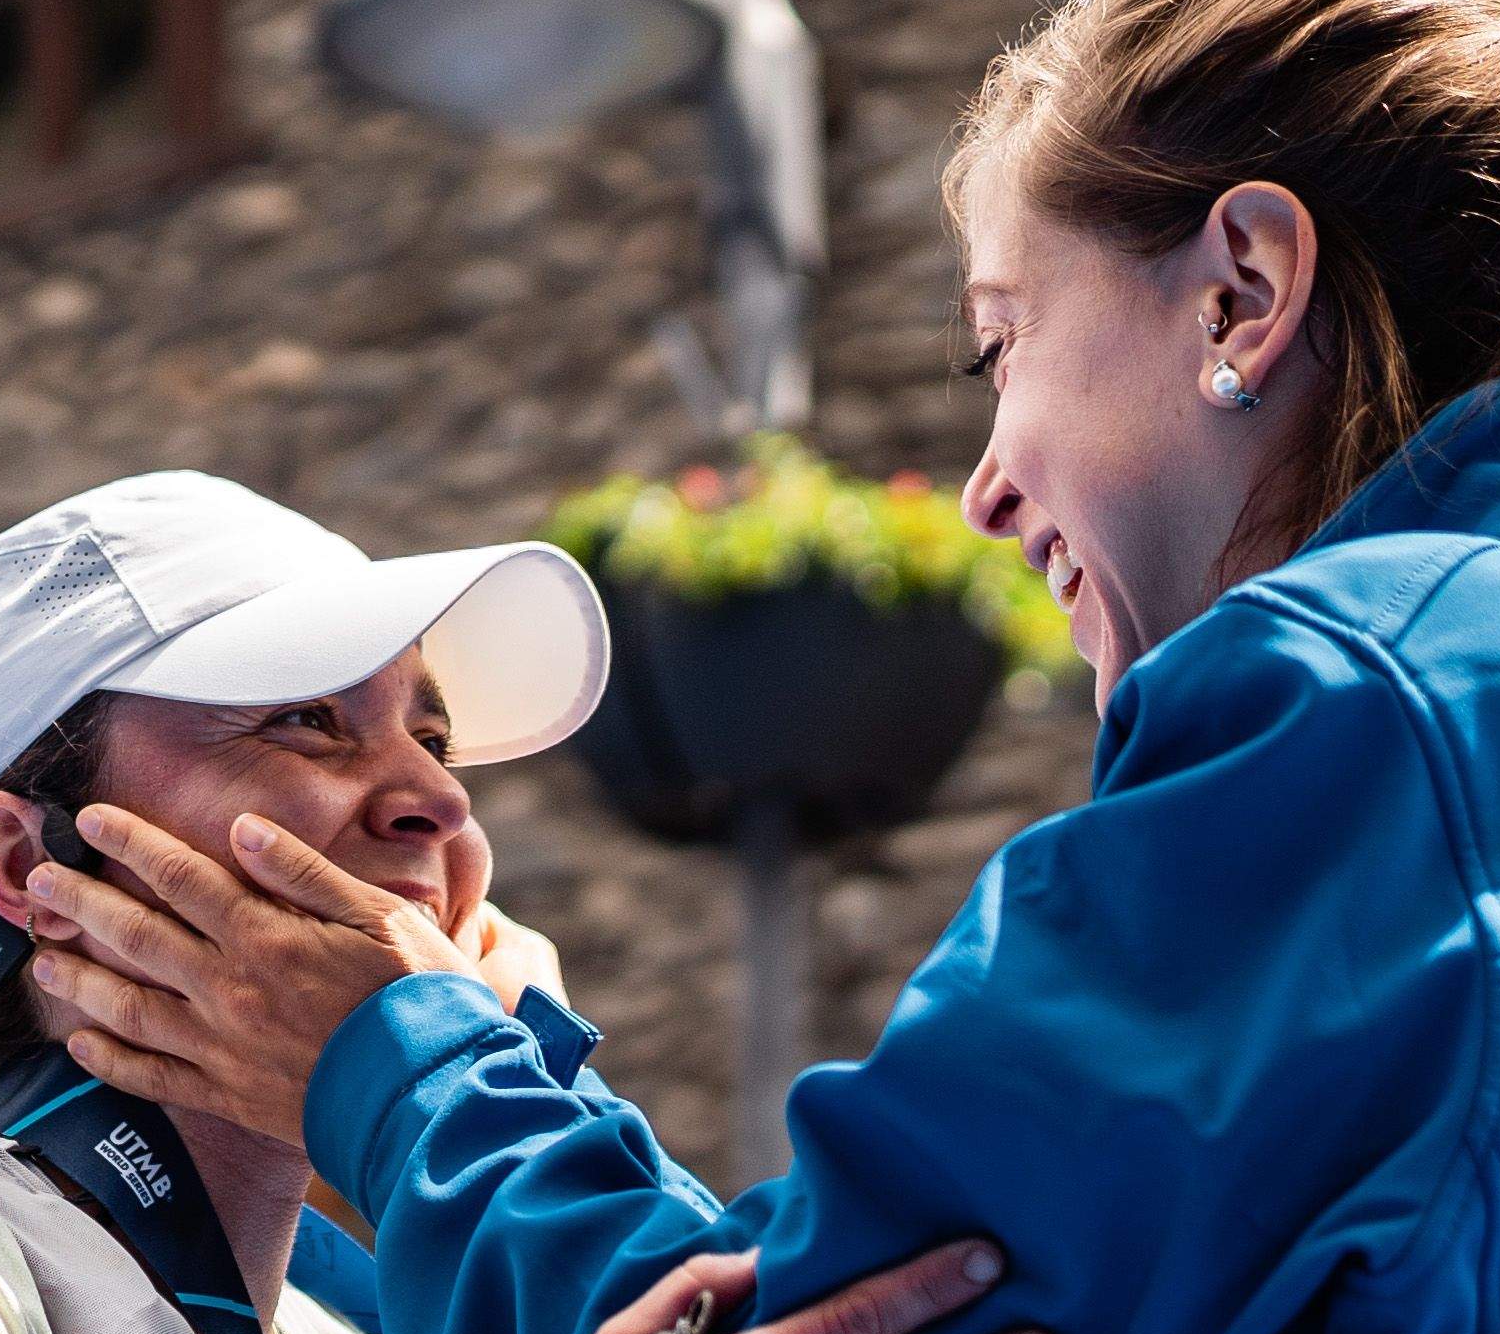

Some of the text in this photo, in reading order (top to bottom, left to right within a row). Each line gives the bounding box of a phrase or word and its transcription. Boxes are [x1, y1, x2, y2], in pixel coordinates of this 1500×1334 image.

[99, 1142, 152, 1204] WORLD SERIES
[109, 1121, 172, 1197] UTMB
